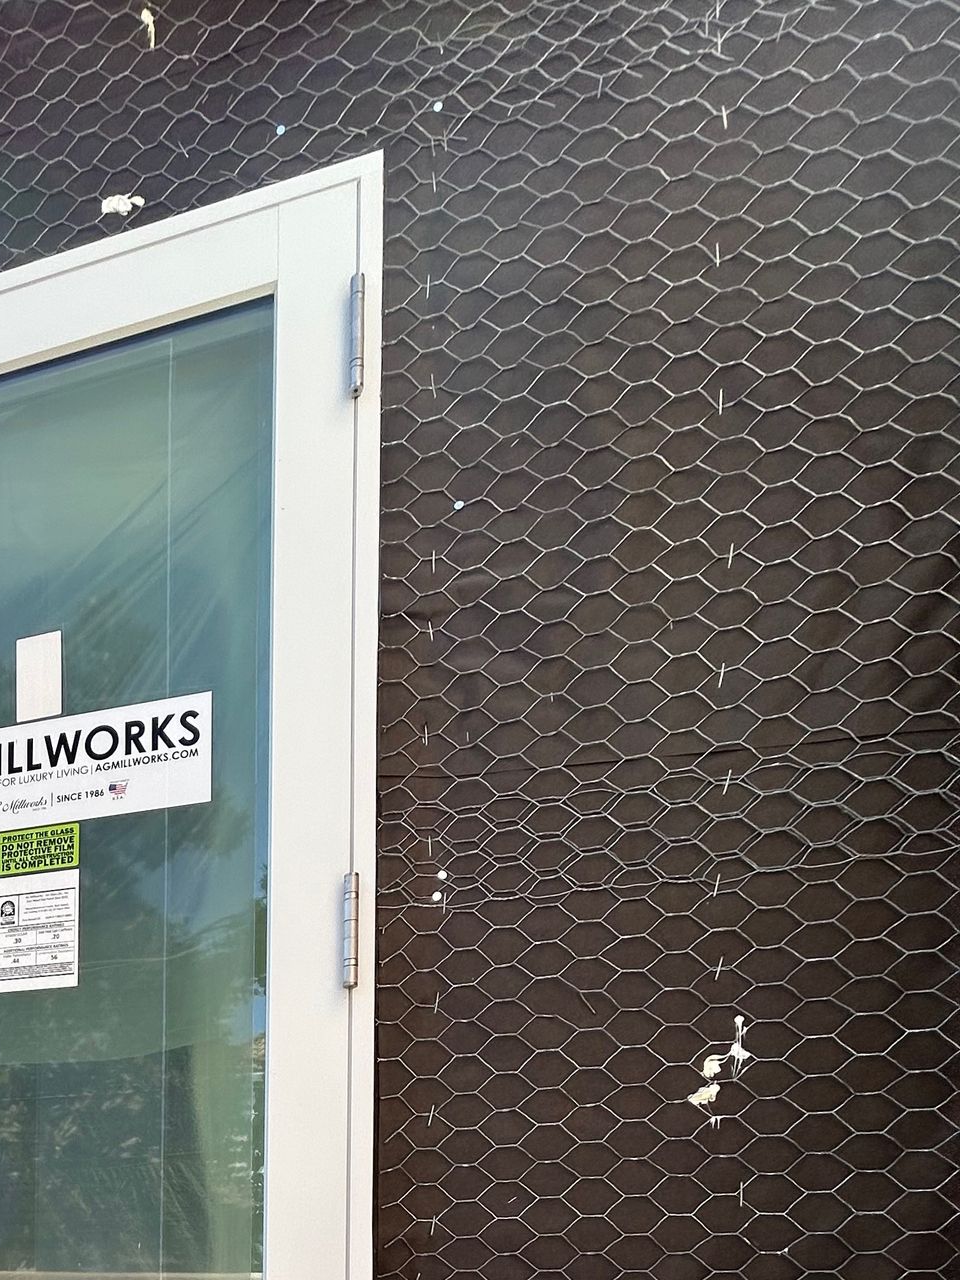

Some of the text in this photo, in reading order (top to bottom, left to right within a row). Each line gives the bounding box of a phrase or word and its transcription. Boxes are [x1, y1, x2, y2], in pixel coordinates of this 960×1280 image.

[18, 771, 54, 785] LUXURY
[56, 765, 89, 779] LIVING
[95, 748, 199, 773] AGMILLWORKS.COM
[56, 792, 82, 803] SINCE
[85, 789, 105, 799] 1986
[3, 832, 34, 843] PROTECT
[50, 827, 74, 836] GLASS
[16, 841, 34, 850] NOT
[36, 836, 75, 847] REMOVE
[2, 843, 74, 859] PROTECTIVE FILM
[14, 855, 74, 870] COMPLETED
